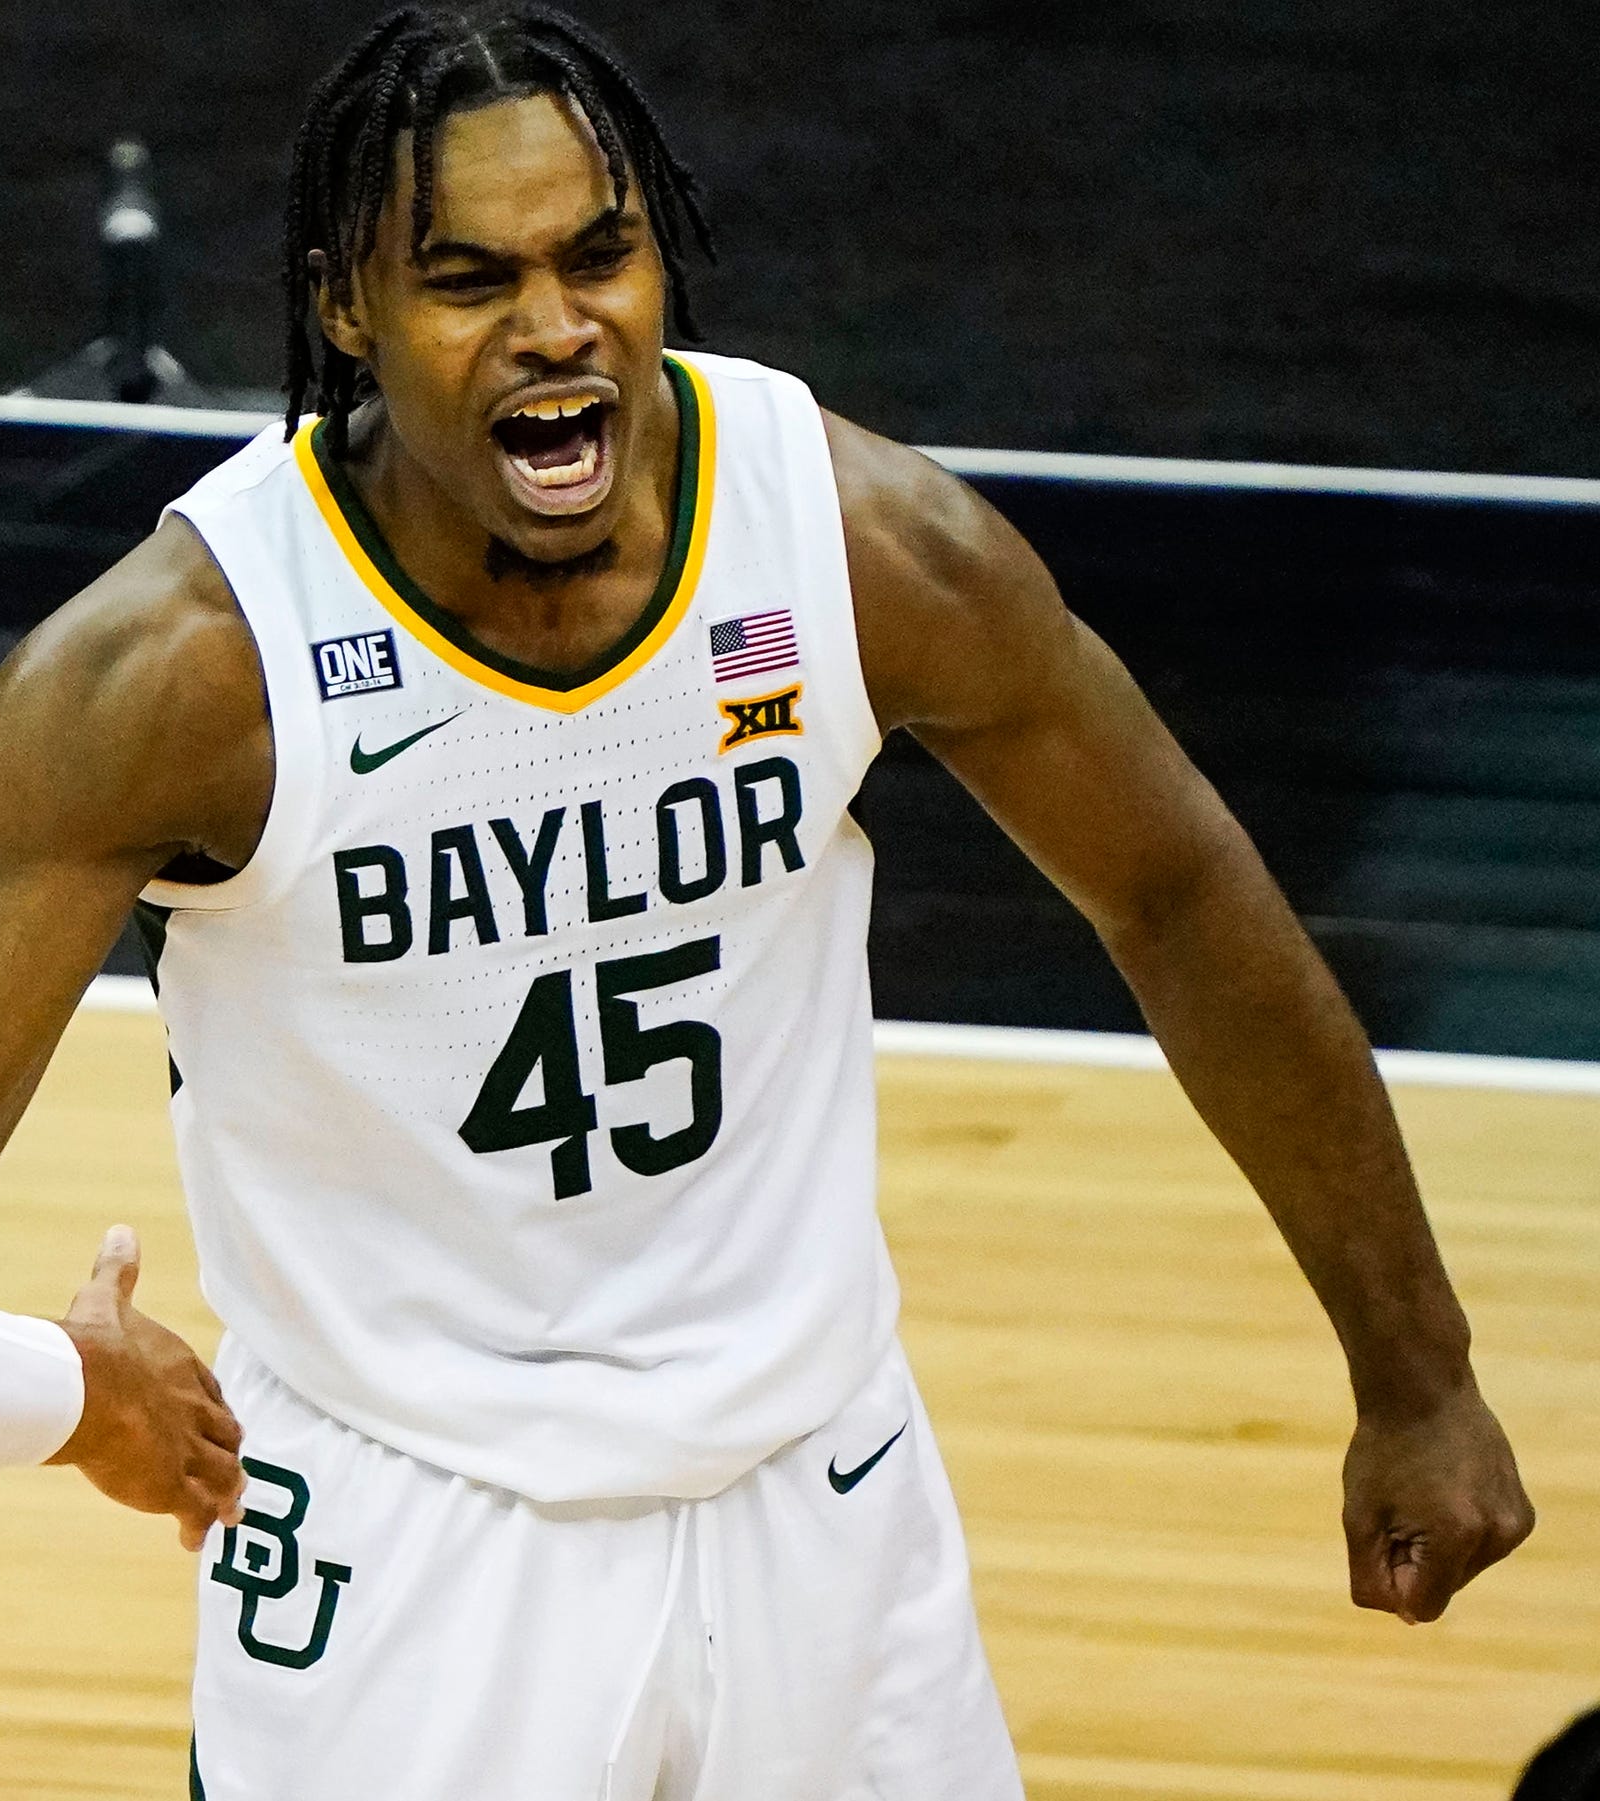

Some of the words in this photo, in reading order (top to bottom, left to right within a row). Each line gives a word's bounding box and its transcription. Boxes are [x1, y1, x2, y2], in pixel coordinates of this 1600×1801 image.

[319, 633, 393, 685] ONE
[725, 689, 799, 747] XII
[333, 756, 806, 963] BAYLOR
[457, 934, 723, 1201] 45
[210, 1455, 353, 1670] BU
